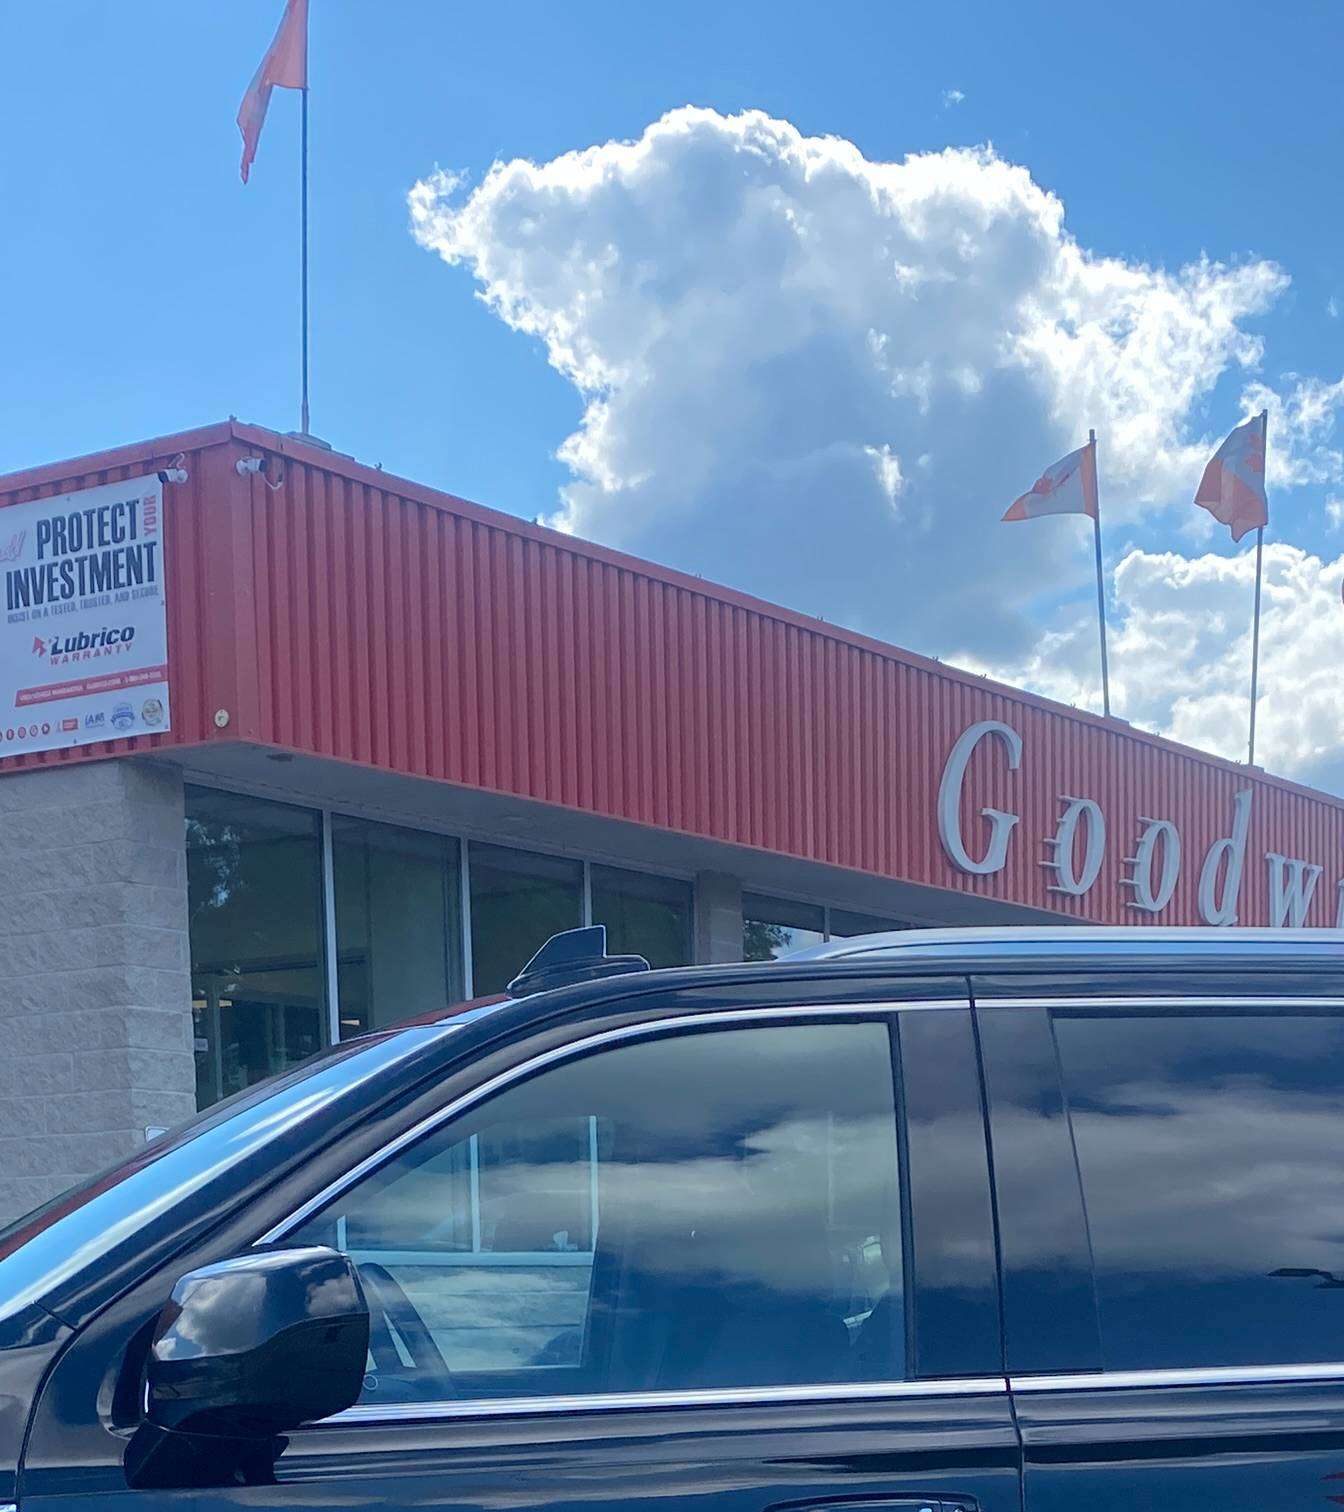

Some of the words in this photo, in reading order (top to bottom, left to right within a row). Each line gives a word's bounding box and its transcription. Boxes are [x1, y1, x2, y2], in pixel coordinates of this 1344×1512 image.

[37, 500, 140, 561] PROTECT
[143, 495, 157, 537] YOUR
[6, 541, 157, 611] INVESTMENT
[50, 626, 135, 656] Lubrico
[50, 642, 133, 666] WARRANTY
